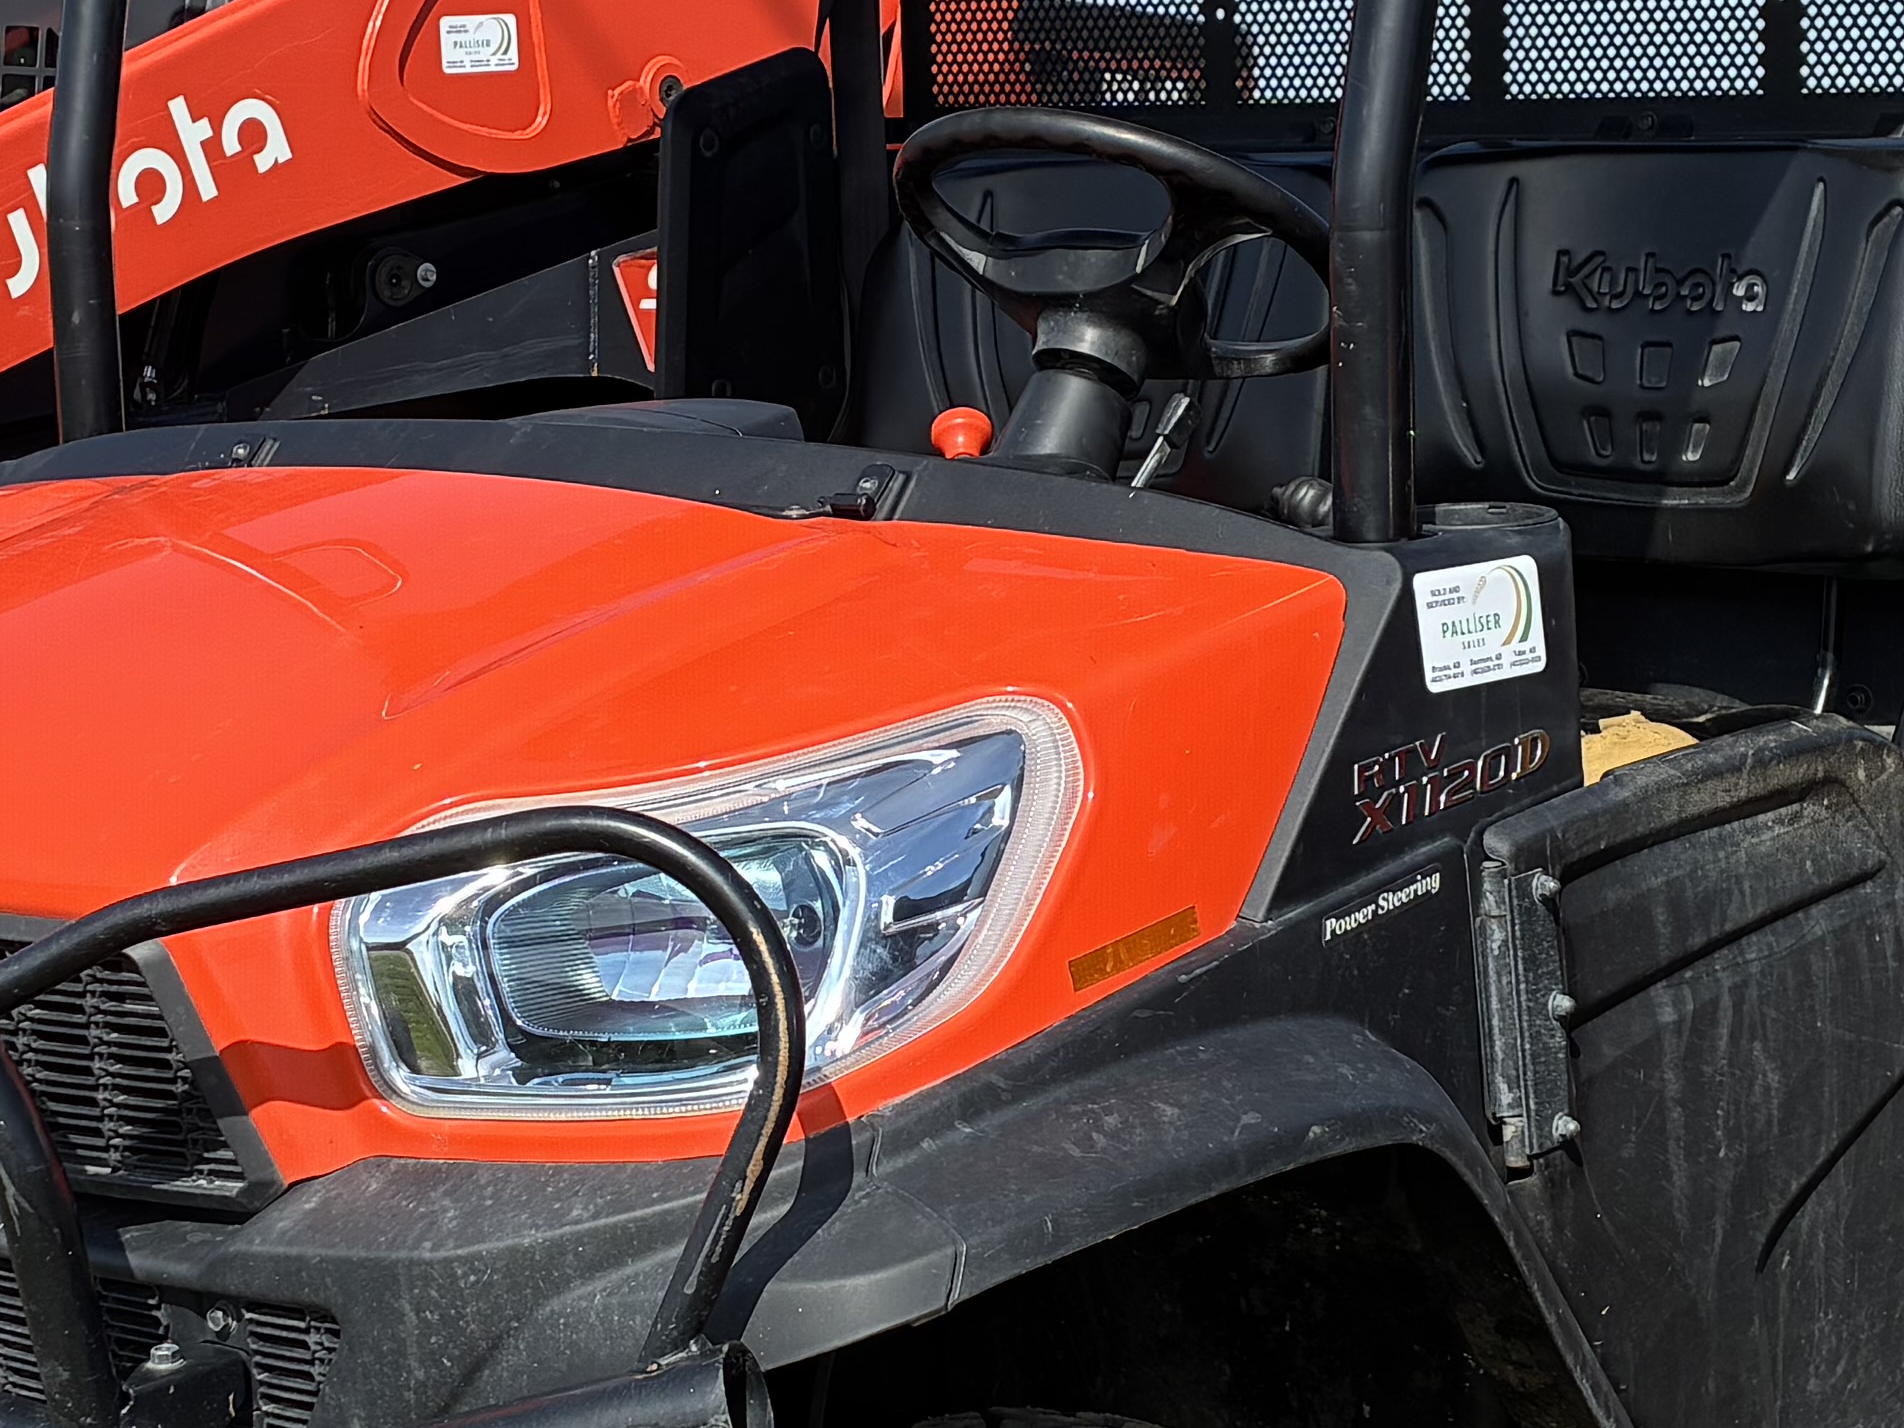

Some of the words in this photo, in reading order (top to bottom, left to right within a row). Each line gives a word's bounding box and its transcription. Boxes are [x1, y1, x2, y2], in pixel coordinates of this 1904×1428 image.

[1551, 249, 1768, 311] Kubota
[1441, 612, 1501, 639] PALLISER
[1462, 637, 1486, 651] SALES
[1353, 732, 1446, 795] RTV
[1324, 904, 1376, 942] Power
[1377, 871, 1441, 915] Steering
